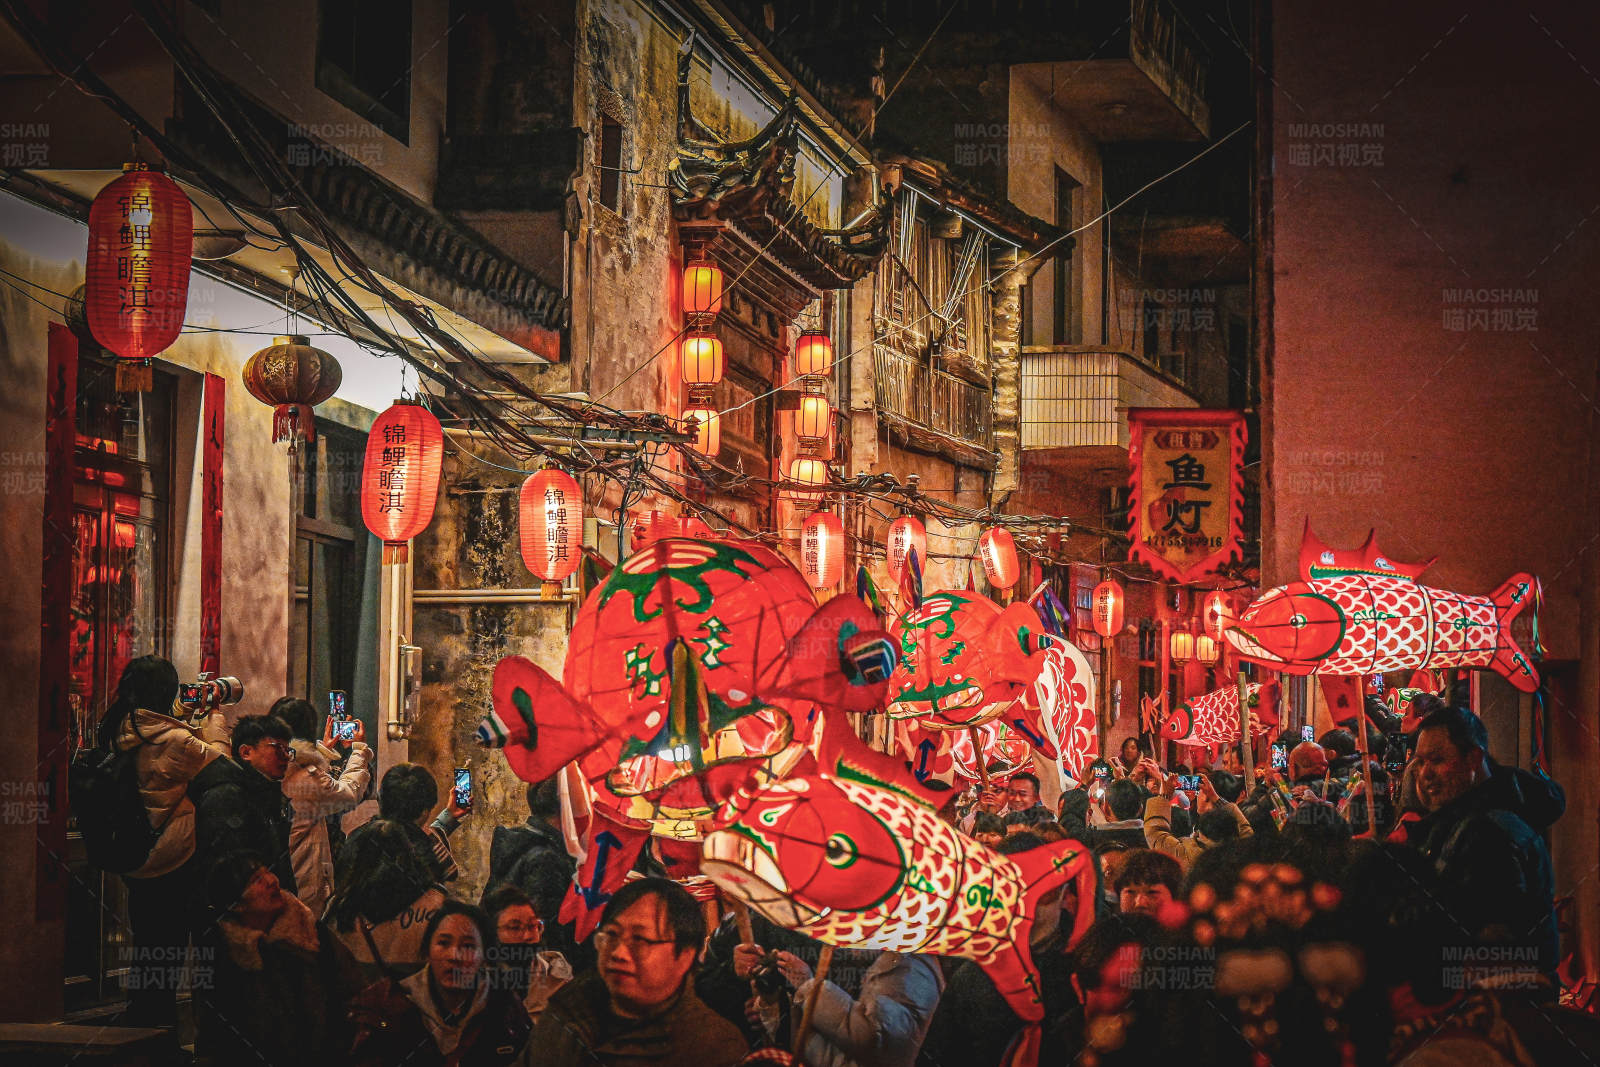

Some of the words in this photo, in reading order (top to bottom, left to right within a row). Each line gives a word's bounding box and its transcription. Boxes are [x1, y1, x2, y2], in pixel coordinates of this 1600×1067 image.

[379, 424, 406, 513] 锦鲤瞻淇
[1162, 453, 1213, 534] 鱼灯
